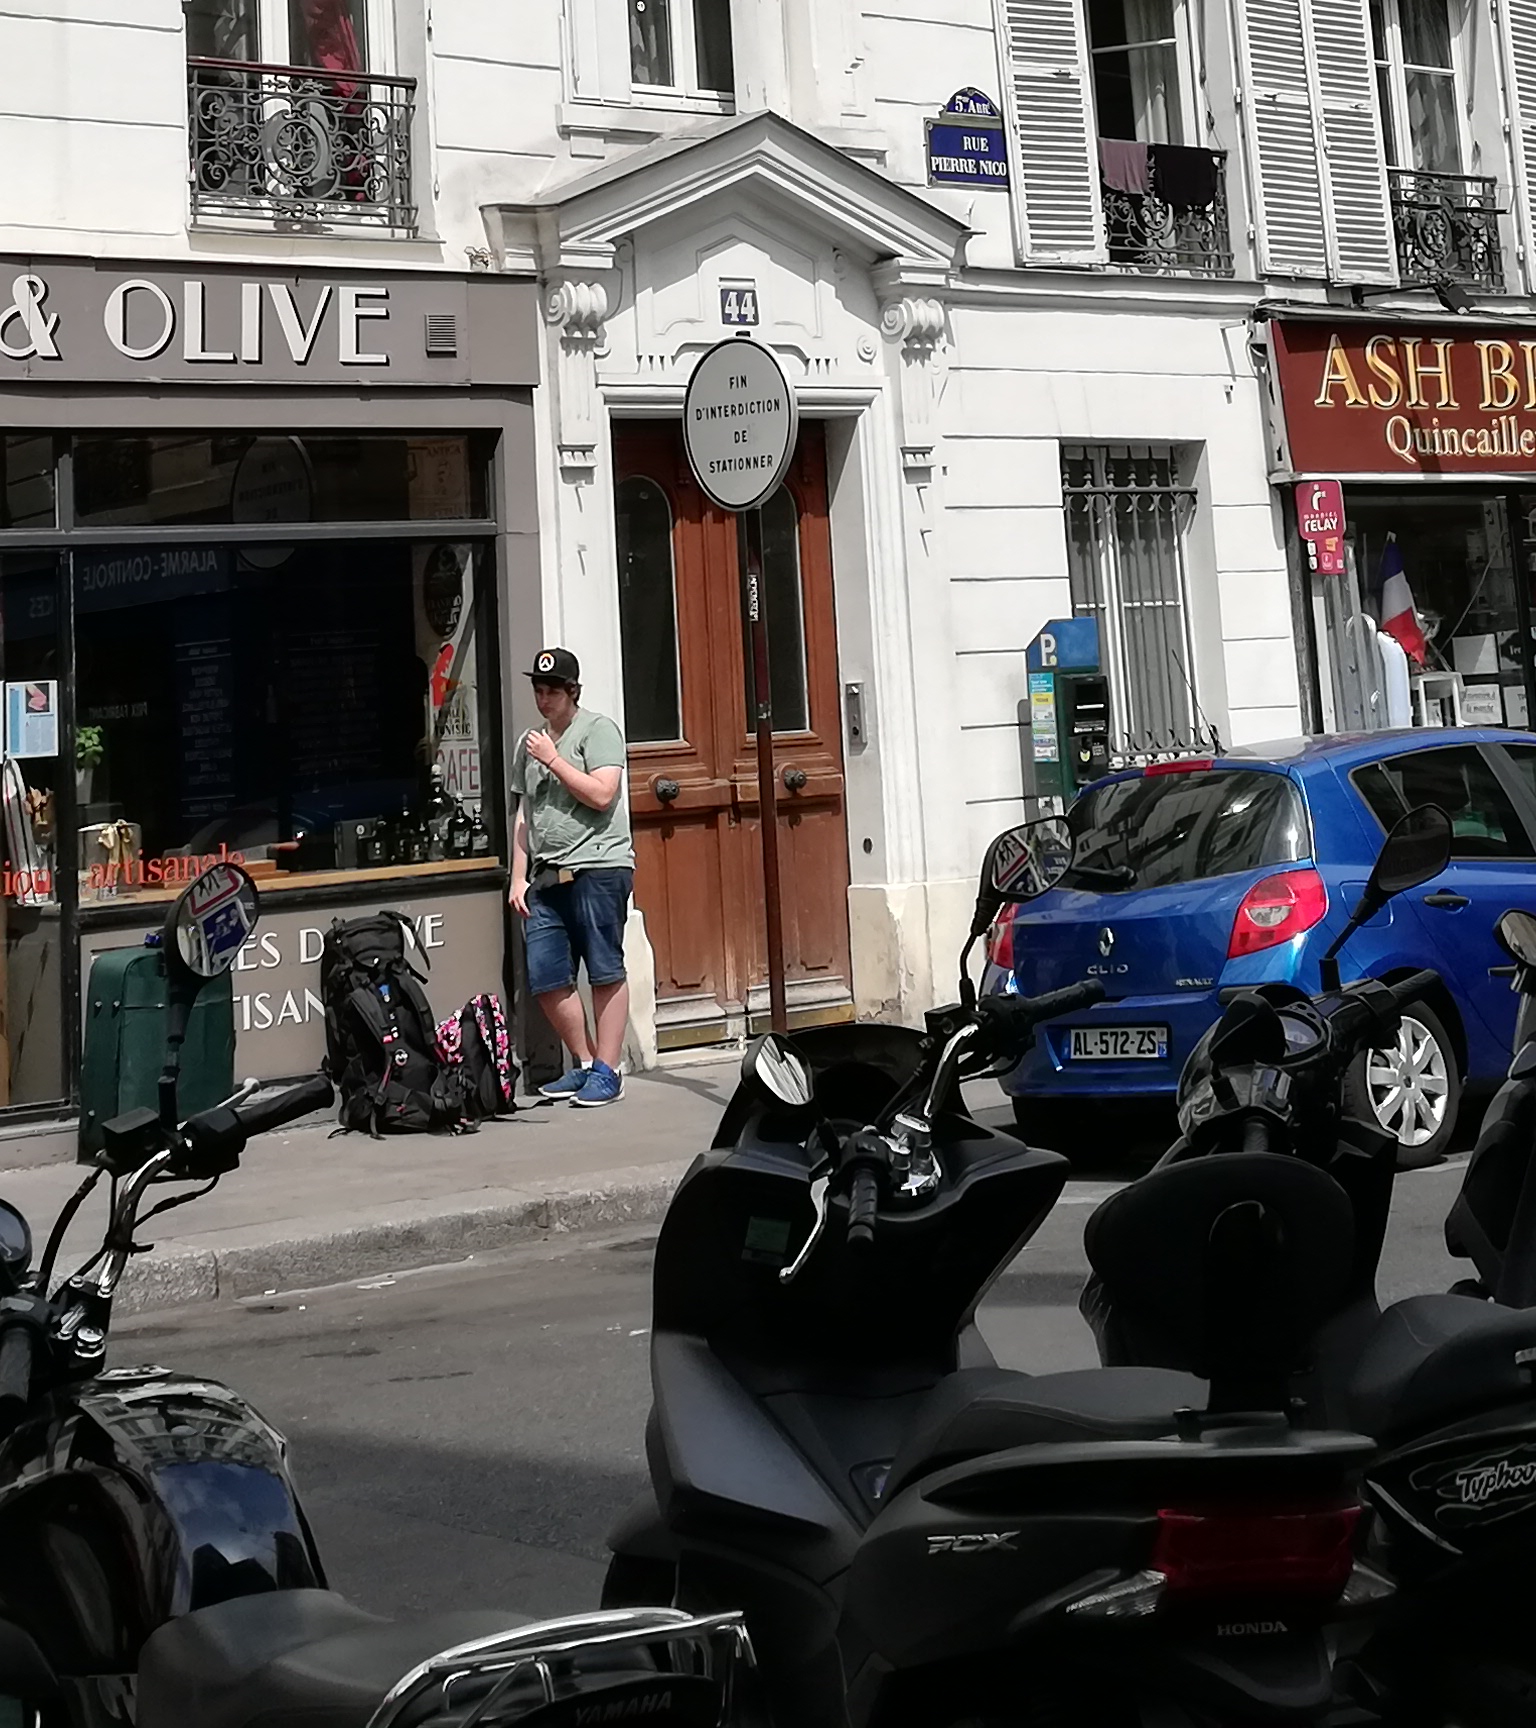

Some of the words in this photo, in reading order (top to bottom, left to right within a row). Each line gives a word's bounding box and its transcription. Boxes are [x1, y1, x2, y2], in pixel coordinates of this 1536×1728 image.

[963, 135, 989, 152] RUE
[930, 156, 977, 174] PIERRE
[724, 291, 755, 323] 44
[101, 277, 391, 366] OLIVE
[729, 375, 748, 390] FIN
[1314, 333, 1461, 412] ASH
[695, 398, 781, 421] D'INTERDICTION
[733, 430, 748, 444] DE
[709, 454, 774, 474] STATIONNER
[1040, 633, 1057, 667] P
[89, 842, 247, 890] artisanale
[1086, 963, 1129, 975] CLIO
[1073, 1029, 1157, 1056] AL-572-ZS
[1216, 1620, 1288, 1636] HONDA
[576, 1690, 672, 1727] YAMAHA
